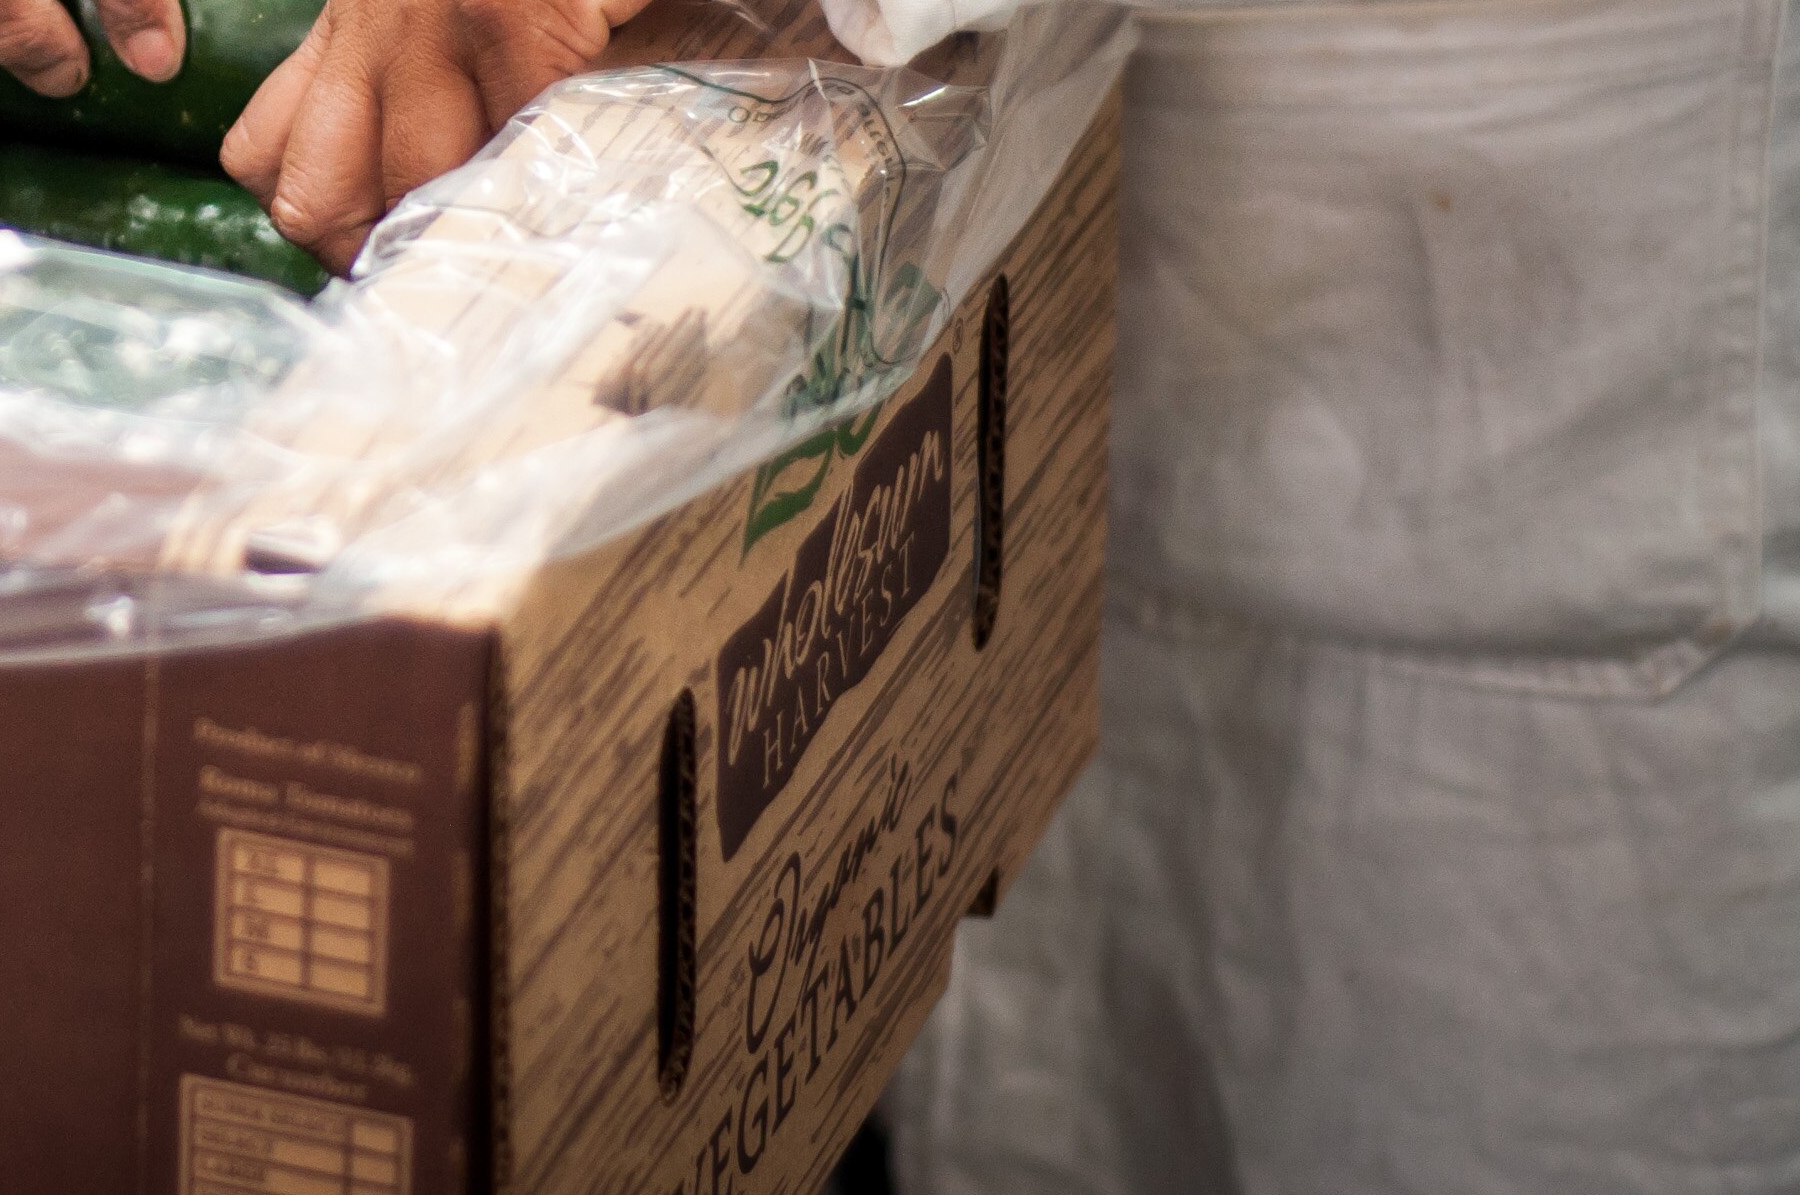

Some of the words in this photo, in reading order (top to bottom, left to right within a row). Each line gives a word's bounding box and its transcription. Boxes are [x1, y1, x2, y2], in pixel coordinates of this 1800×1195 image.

[726, 429, 944, 766] wholesum
[763, 531, 916, 789] HARVEST
[746, 753, 912, 1054] Organic
